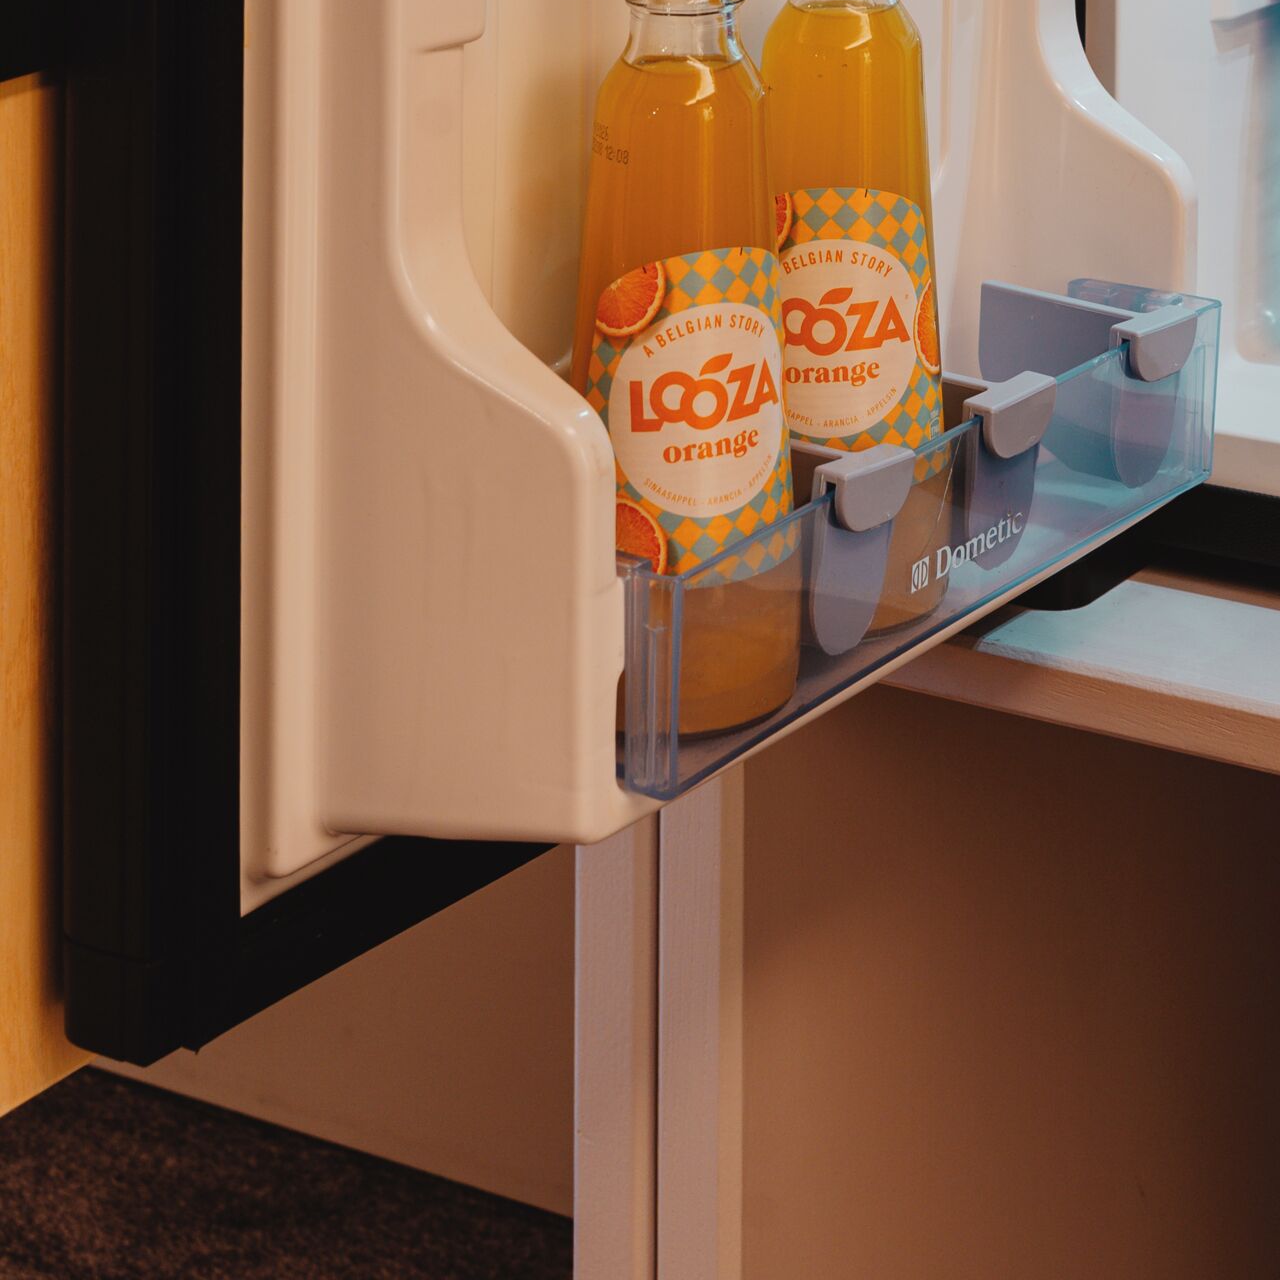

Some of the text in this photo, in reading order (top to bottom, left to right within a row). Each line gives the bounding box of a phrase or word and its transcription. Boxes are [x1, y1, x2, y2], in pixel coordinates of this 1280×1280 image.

[783, 249, 893, 278] BELGIAN STORY
[642, 313, 766, 359] A BELGIAN STORY
[785, 361, 881, 388] orange
[823, 415, 859, 428] ARANCIA
[866, 386, 898, 417] APPELSIN
[662, 428, 760, 464] orange
[642, 477, 697, 507] SINAASAPPEL
[935, 511, 1024, 580] Dometic
